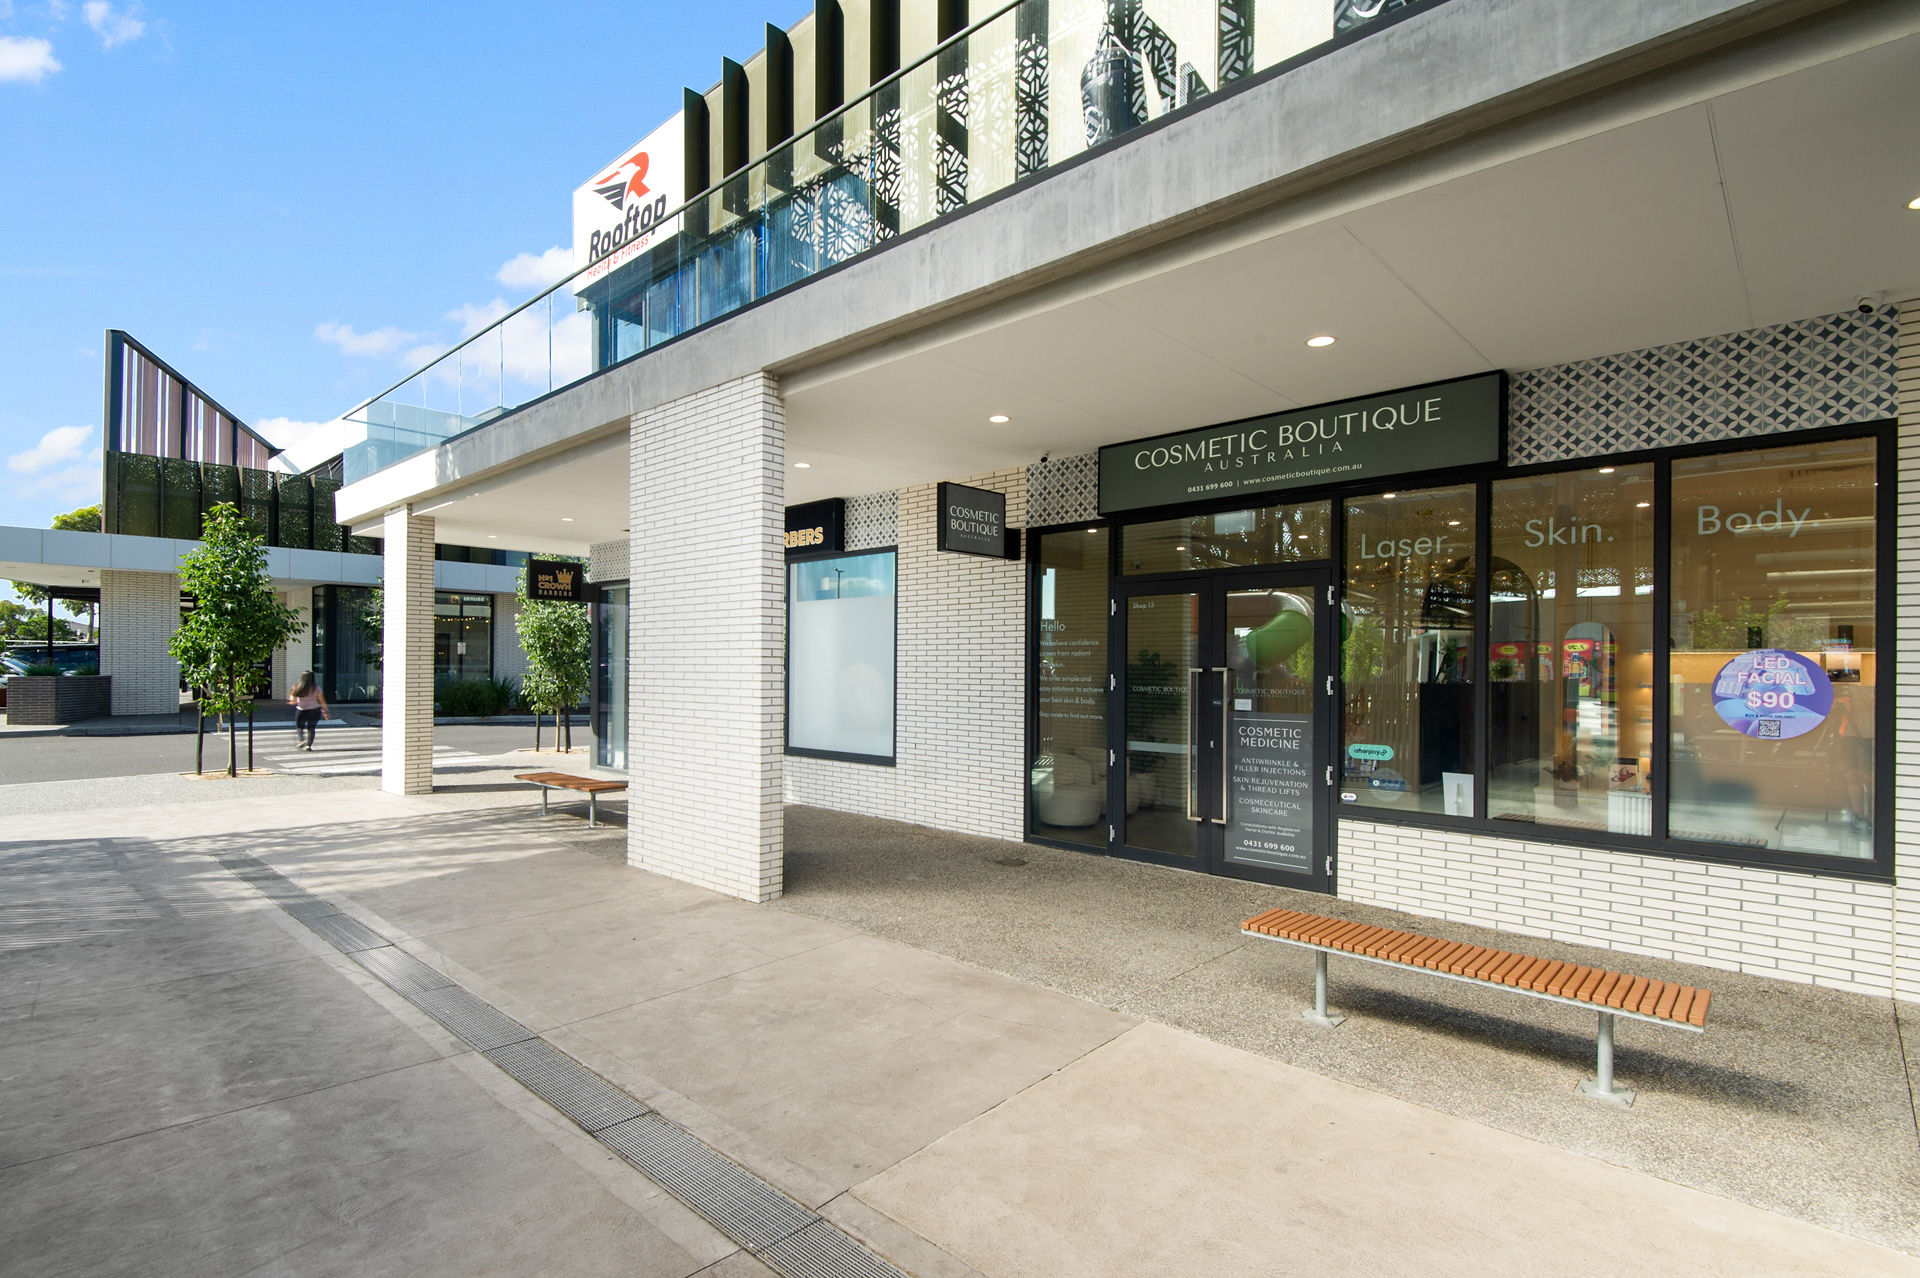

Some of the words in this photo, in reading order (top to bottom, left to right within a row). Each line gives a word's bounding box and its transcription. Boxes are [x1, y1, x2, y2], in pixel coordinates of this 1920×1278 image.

[588, 193, 666, 263] Rooftop
[1135, 429, 1267, 470] COSMETIC
[1279, 397, 1441, 447] BOUTIQUE
[1204, 441, 1343, 473] AUSTRALIA
[1187, 485, 1204, 493] 0431
[1205, 483, 1218, 491] 699
[1243, 463, 1362, 485] www.cosmeticboutique.com.au
[950, 505, 999, 524] COSMETIC
[1698, 498, 1819, 538] Body.
[951, 518, 999, 537] BOUTIQUE
[1524, 516, 1614, 548] Skin.
[1361, 533, 1454, 559] Laser.
[538, 582, 572, 591] CROWN
[1040, 621, 1066, 632] Hello
[1753, 656, 1790, 670] LED
[1737, 671, 1807, 686] FACIAL
[1270, 688, 1306, 696] BOUTIQUE
[1747, 689, 1795, 709] $90
[1238, 726, 1302, 739] COSMETIC
[1241, 737, 1300, 750] MEDICINE
[1241, 757, 1292, 767] ANTIWRINKLE
[1293, 760, 1299, 768] &
[1234, 764, 1259, 773] FILLER
[1261, 767, 1306, 777] INJECTIONS
[1232, 775, 1249, 784] SKIN
[1251, 777, 1309, 789] REJUVENATION
[1248, 785, 1277, 794] THREAD
[1279, 788, 1301, 796] LIFTS
[1238, 797, 1302, 810] COSMECEUTICAL
[1251, 806, 1288, 817] SKINCARE
[1243, 839, 1262, 848] 0431
[1264, 842, 1278, 850] 699
[1280, 844, 1295, 852] 600
